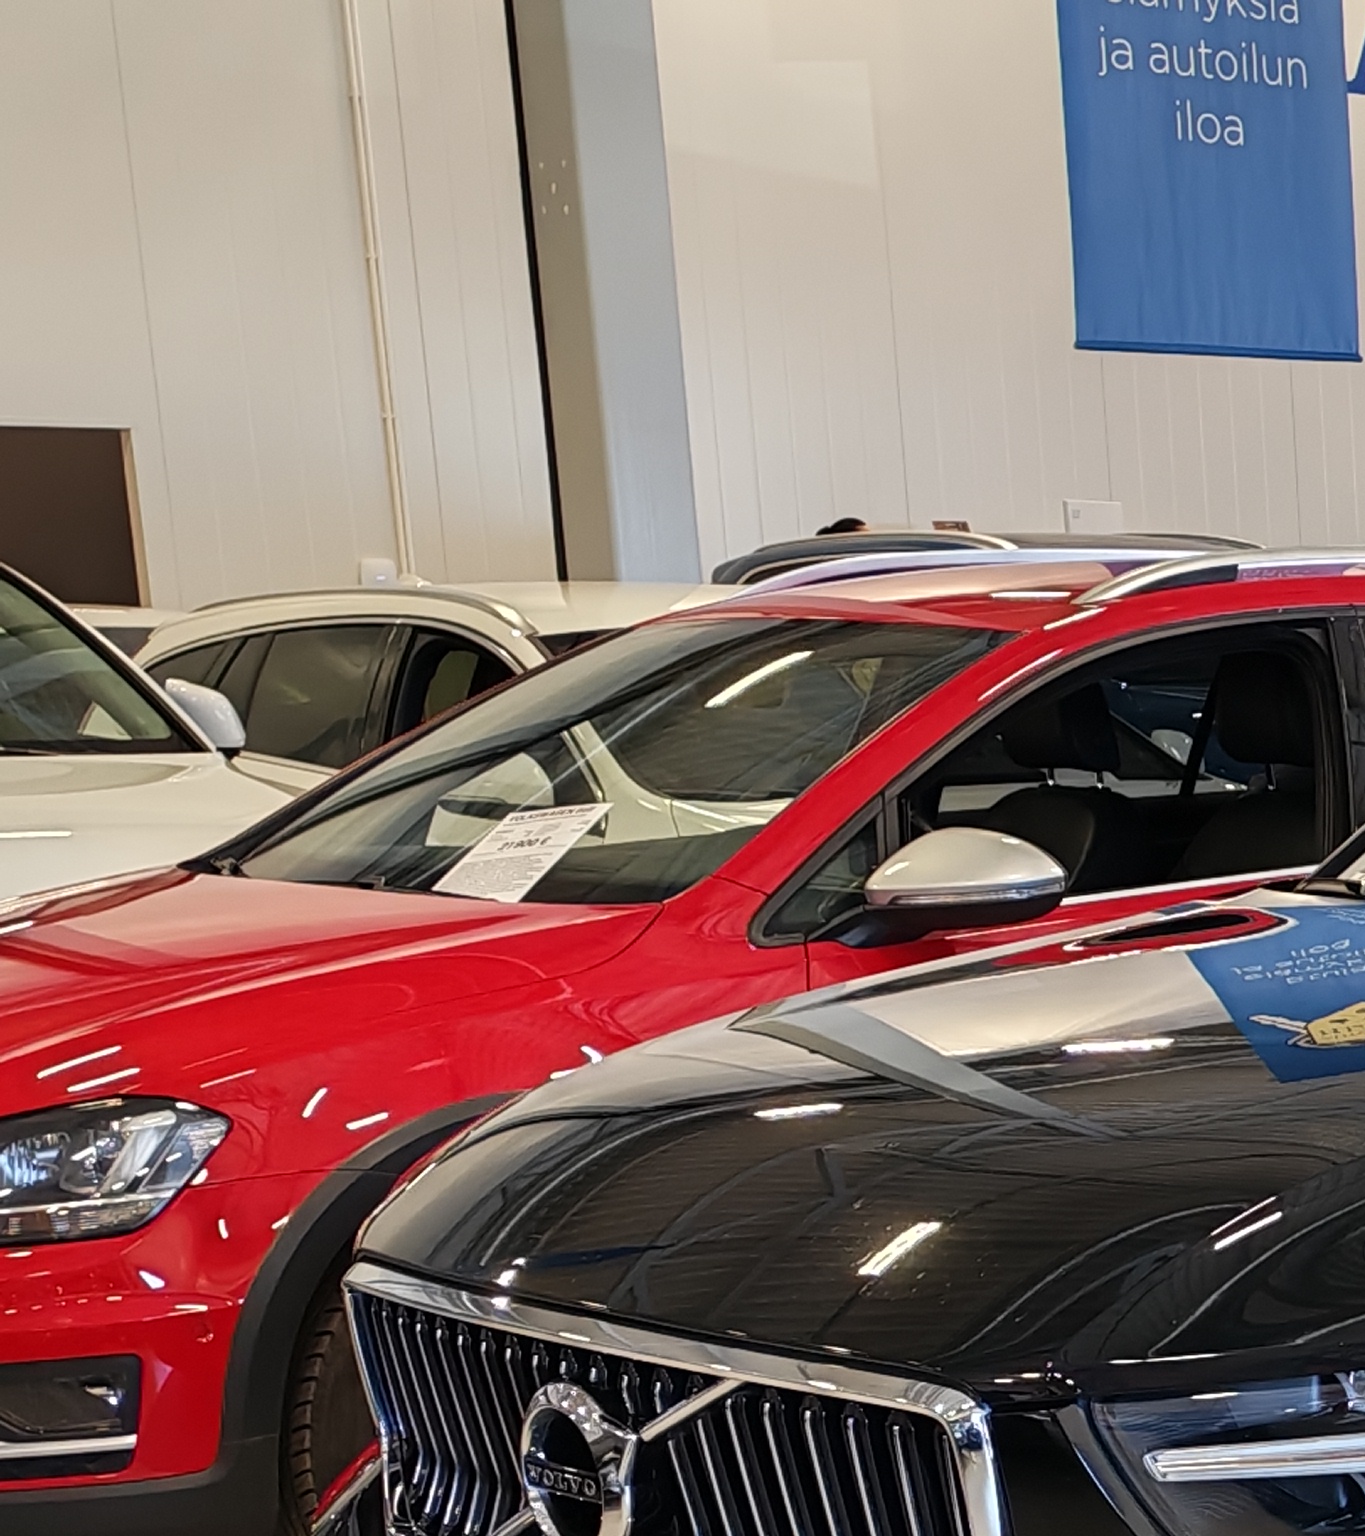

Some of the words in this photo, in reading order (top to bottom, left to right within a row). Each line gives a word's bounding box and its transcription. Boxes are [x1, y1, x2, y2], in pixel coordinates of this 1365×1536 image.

[1099, 25, 1134, 76] ja
[1150, 39, 1307, 89] autoilun
[1175, 99, 1244, 146] iloa
[526, 1462, 598, 1497] VOLVO
